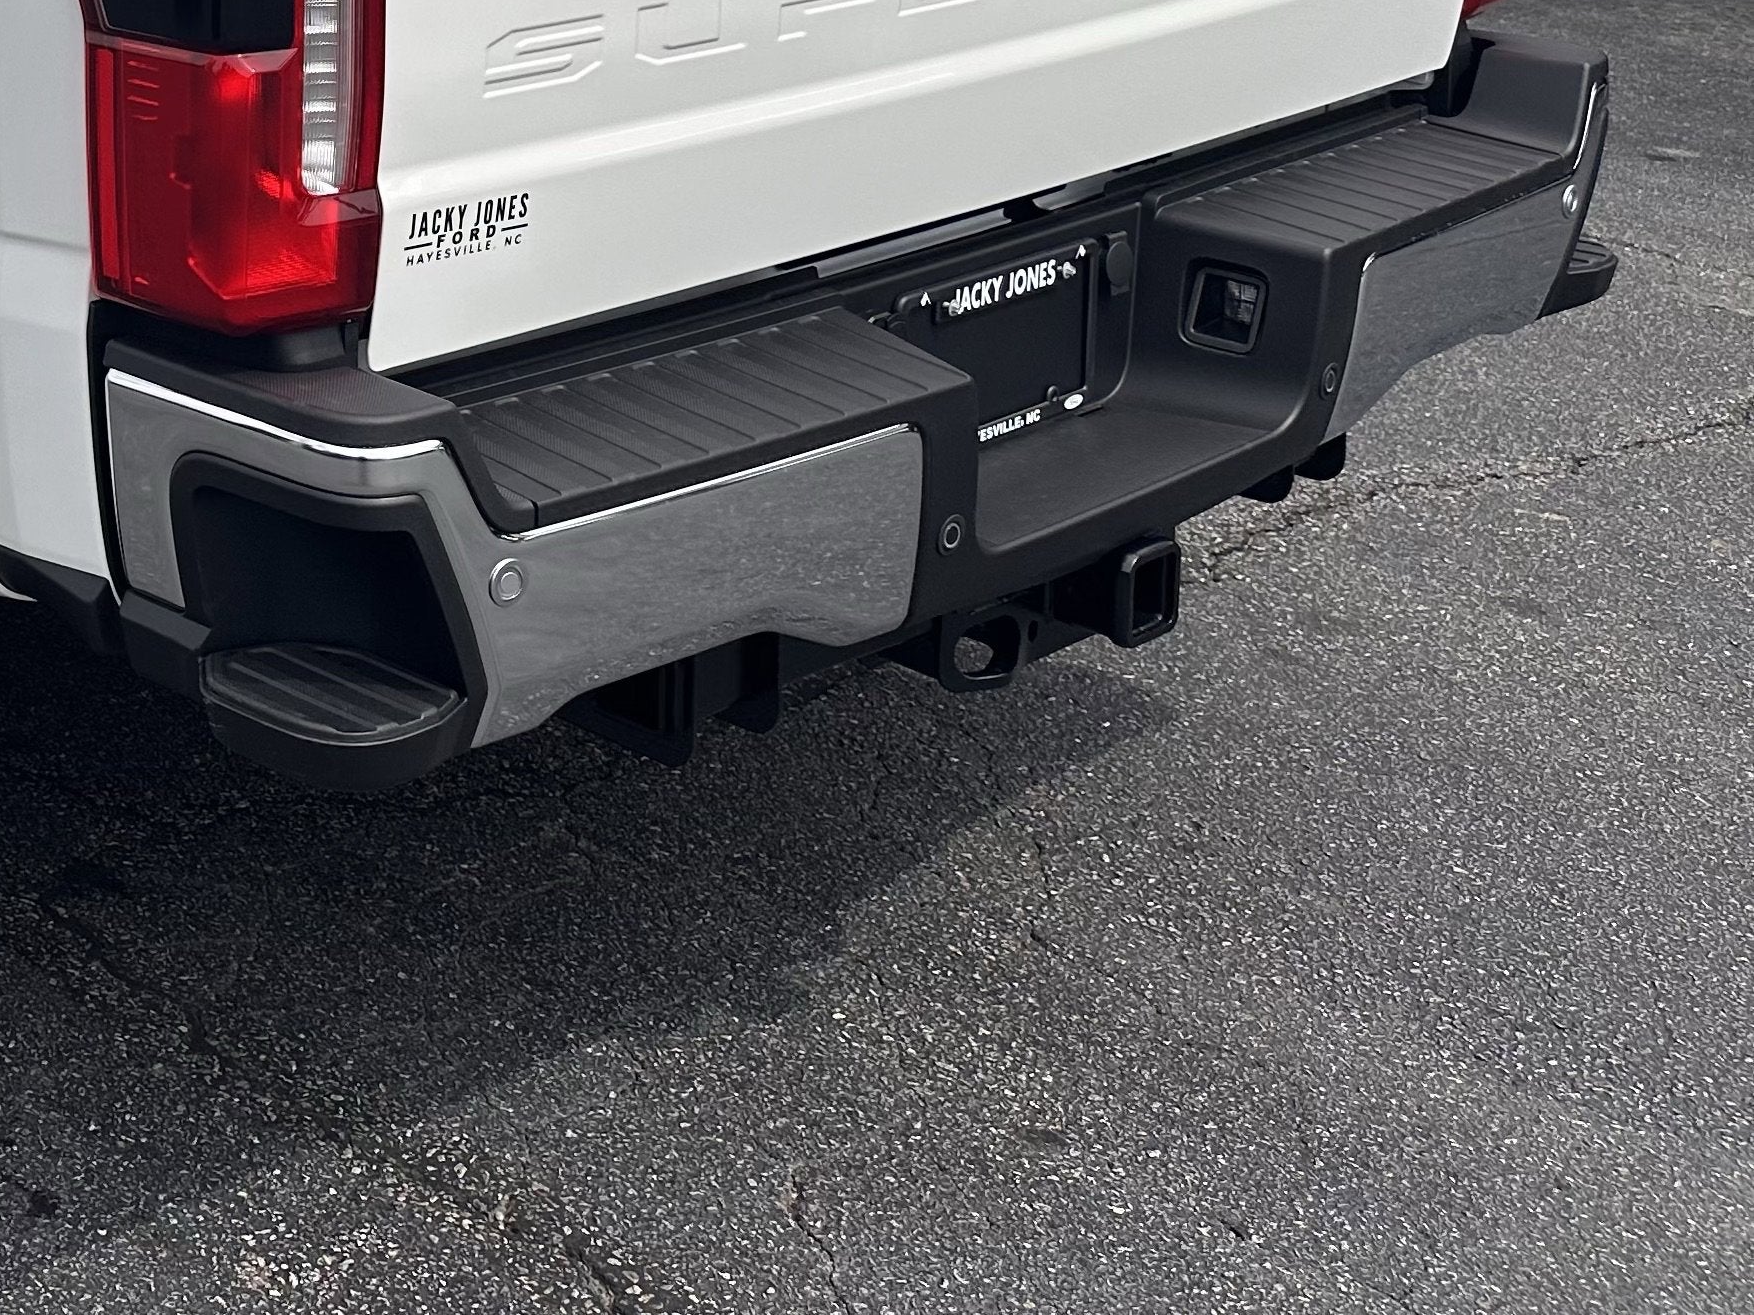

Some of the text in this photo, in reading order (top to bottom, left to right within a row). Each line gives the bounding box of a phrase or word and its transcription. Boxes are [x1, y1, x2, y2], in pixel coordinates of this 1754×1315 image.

[408, 192, 529, 240] JACKY JONES
[436, 224, 496, 248] FORD
[504, 233, 523, 247] NC
[953, 258, 1057, 315] JACKY JONES
[1025, 408, 1041, 425] NC
